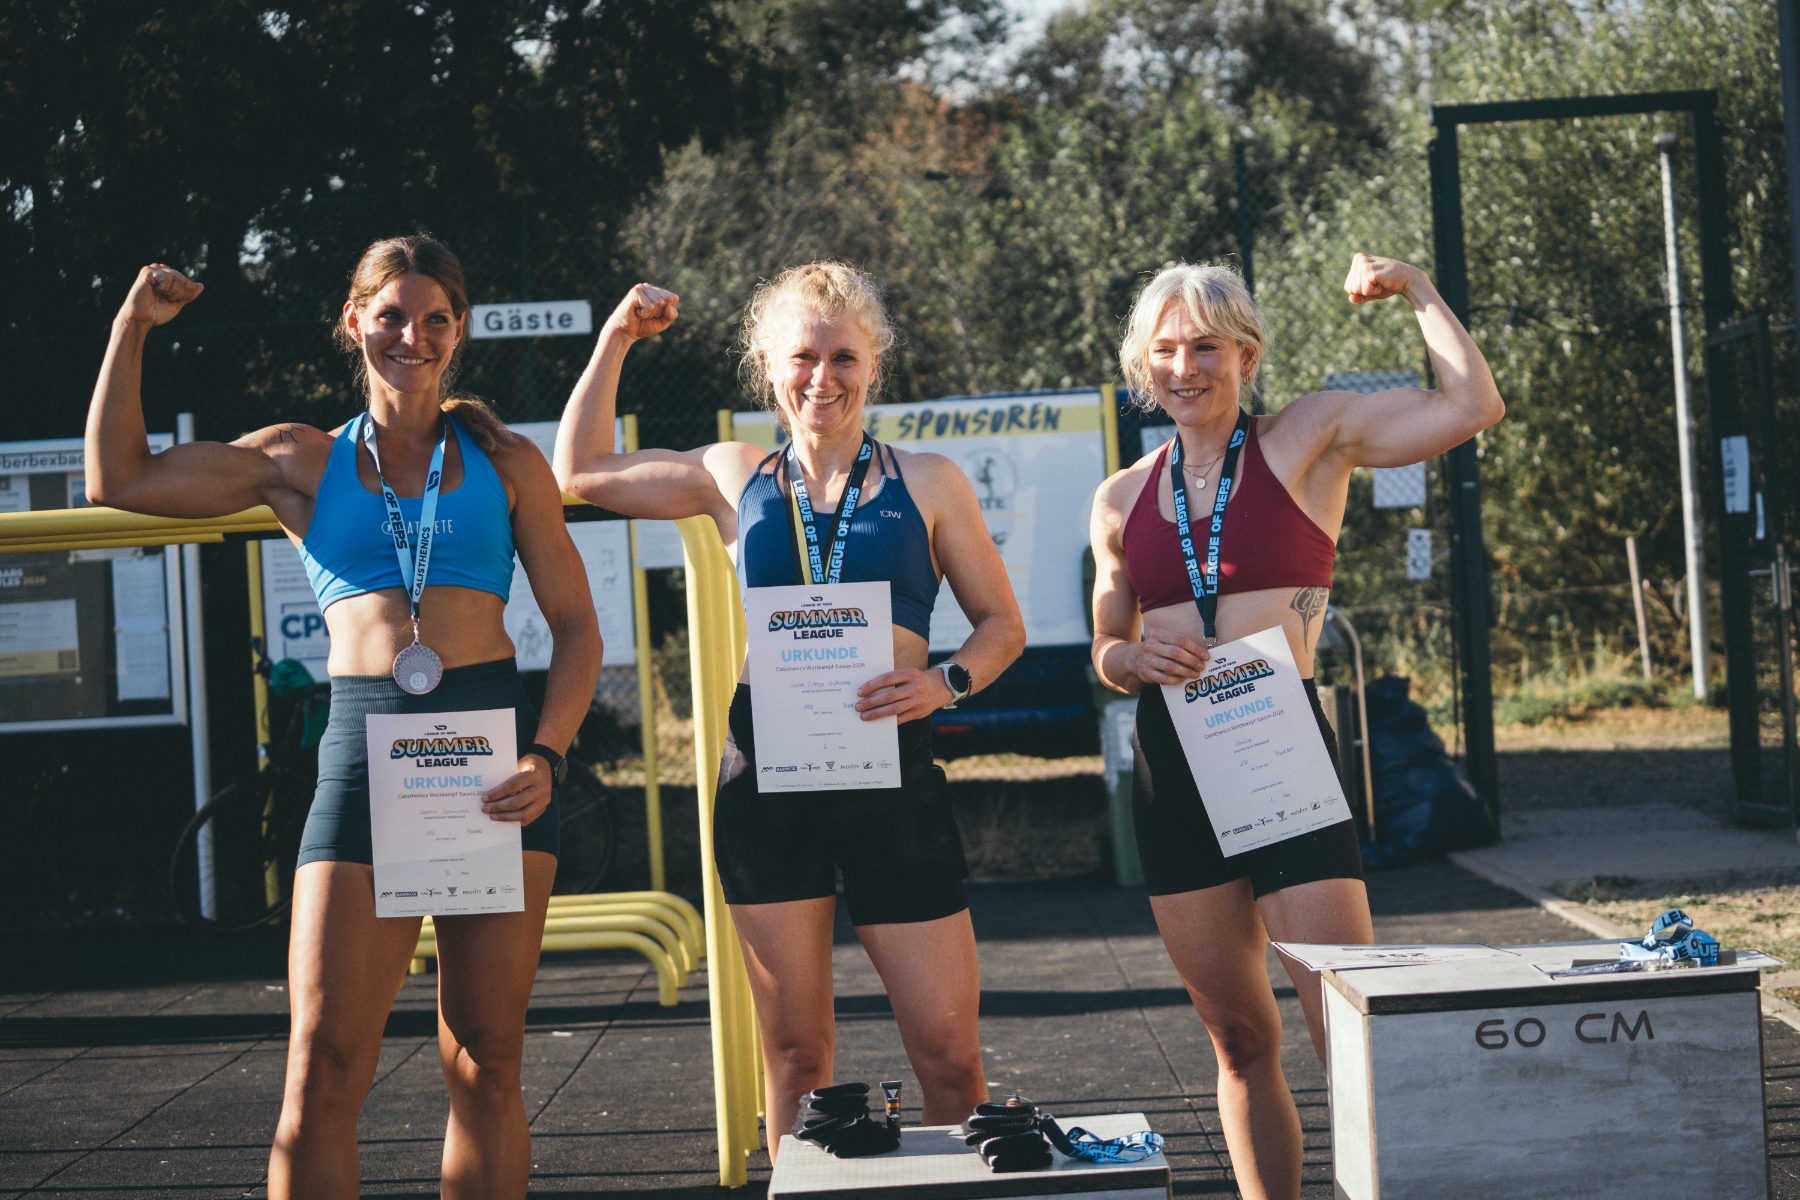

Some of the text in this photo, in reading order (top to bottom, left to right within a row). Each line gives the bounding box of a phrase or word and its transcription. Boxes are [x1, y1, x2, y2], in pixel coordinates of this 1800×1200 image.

[484, 308, 574, 332] Gäste
[898, 401, 1062, 440] SPONSOREN
[0, 452, 85, 470] berbexbac
[384, 491, 408, 550] OF REPS
[407, 520, 454, 535] ATETE
[793, 479, 825, 583] LEAGUE OF REPS
[828, 486, 860, 584] EAGUE OF REPS
[1173, 488, 1205, 599] LEAGUE OF REPS
[1206, 477, 1232, 595] LEAGUE OF REPS
[415, 526, 430, 596] CALISTHENICS
[281, 613, 330, 639] CP
[768, 607, 868, 632] SUMMER
[793, 629, 844, 640] LEAGUE
[781, 647, 858, 662] URKUNDE
[1184, 658, 1274, 703] SUMMER
[1209, 682, 1256, 705] LEAGUE
[1203, 696, 1275, 729] URKUNDE
[390, 736, 493, 759] SUMMER
[416, 757, 468, 768] LEAGUE
[403, 775, 483, 790] URKUNDE
[1474, 1010, 1655, 1050] 60 CM
